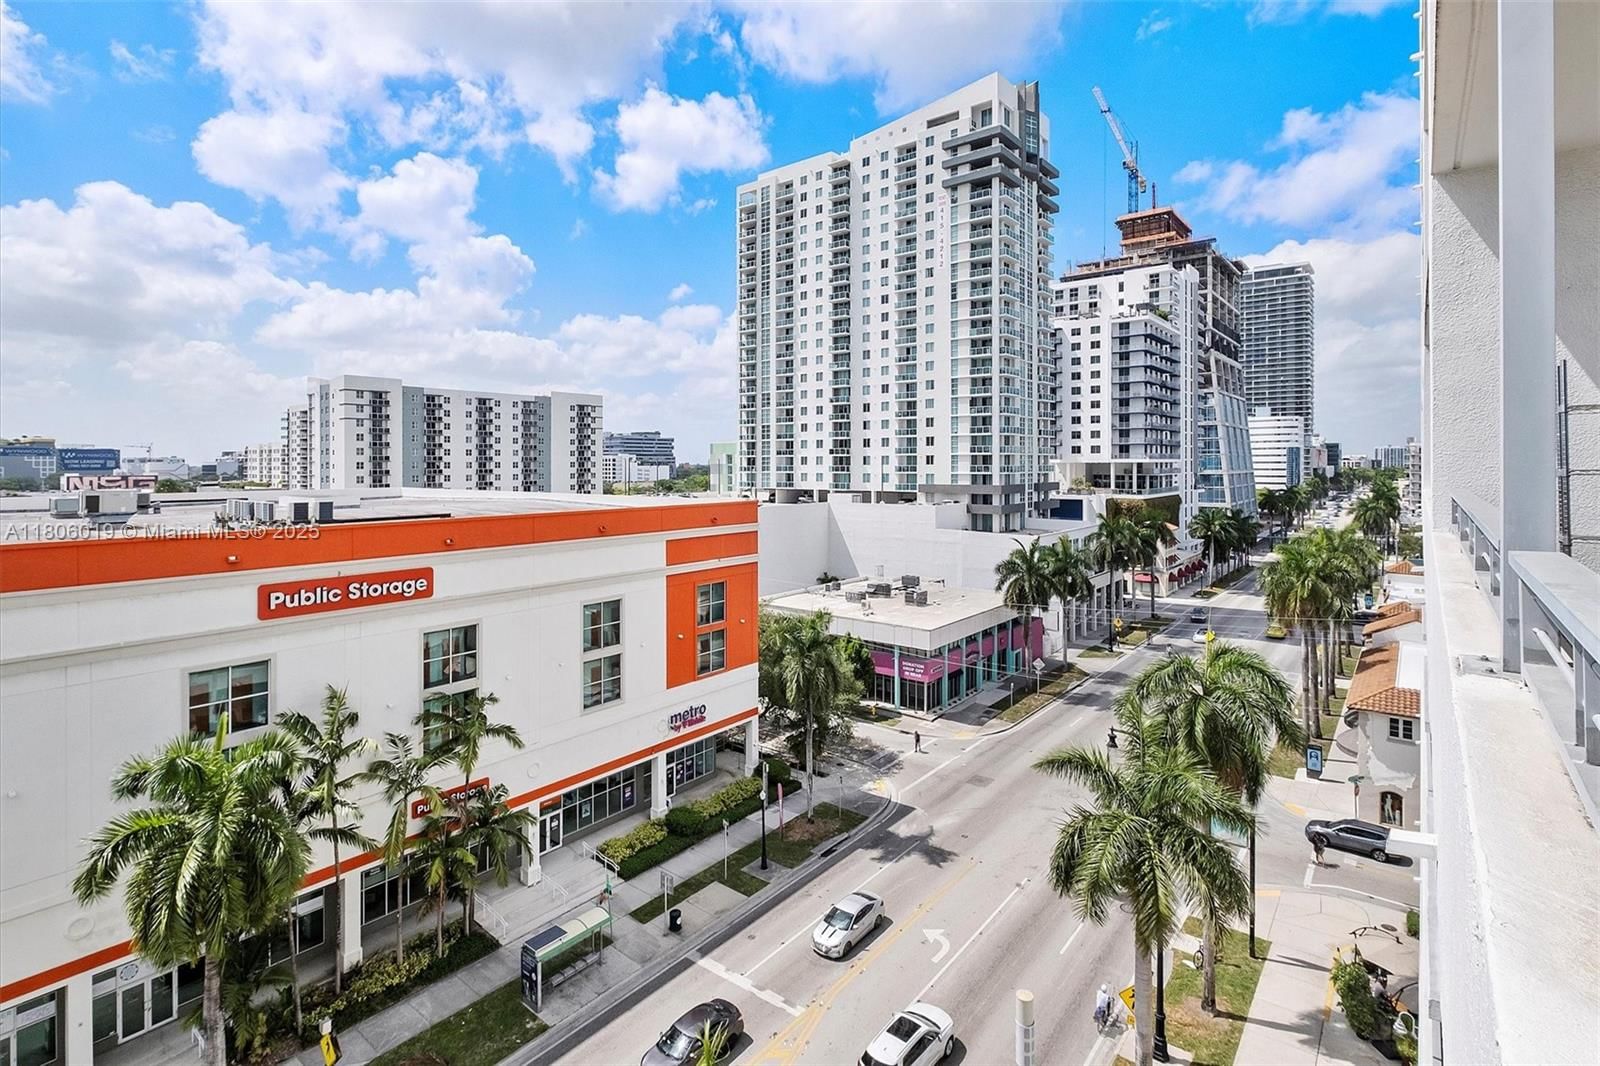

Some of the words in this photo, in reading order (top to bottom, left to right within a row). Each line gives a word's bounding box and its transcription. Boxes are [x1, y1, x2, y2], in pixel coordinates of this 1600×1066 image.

[269, 585, 342, 610] Public
[348, 578, 428, 597] Storage
[670, 704, 706, 724] metro
[416, 797, 449, 815] Puc
